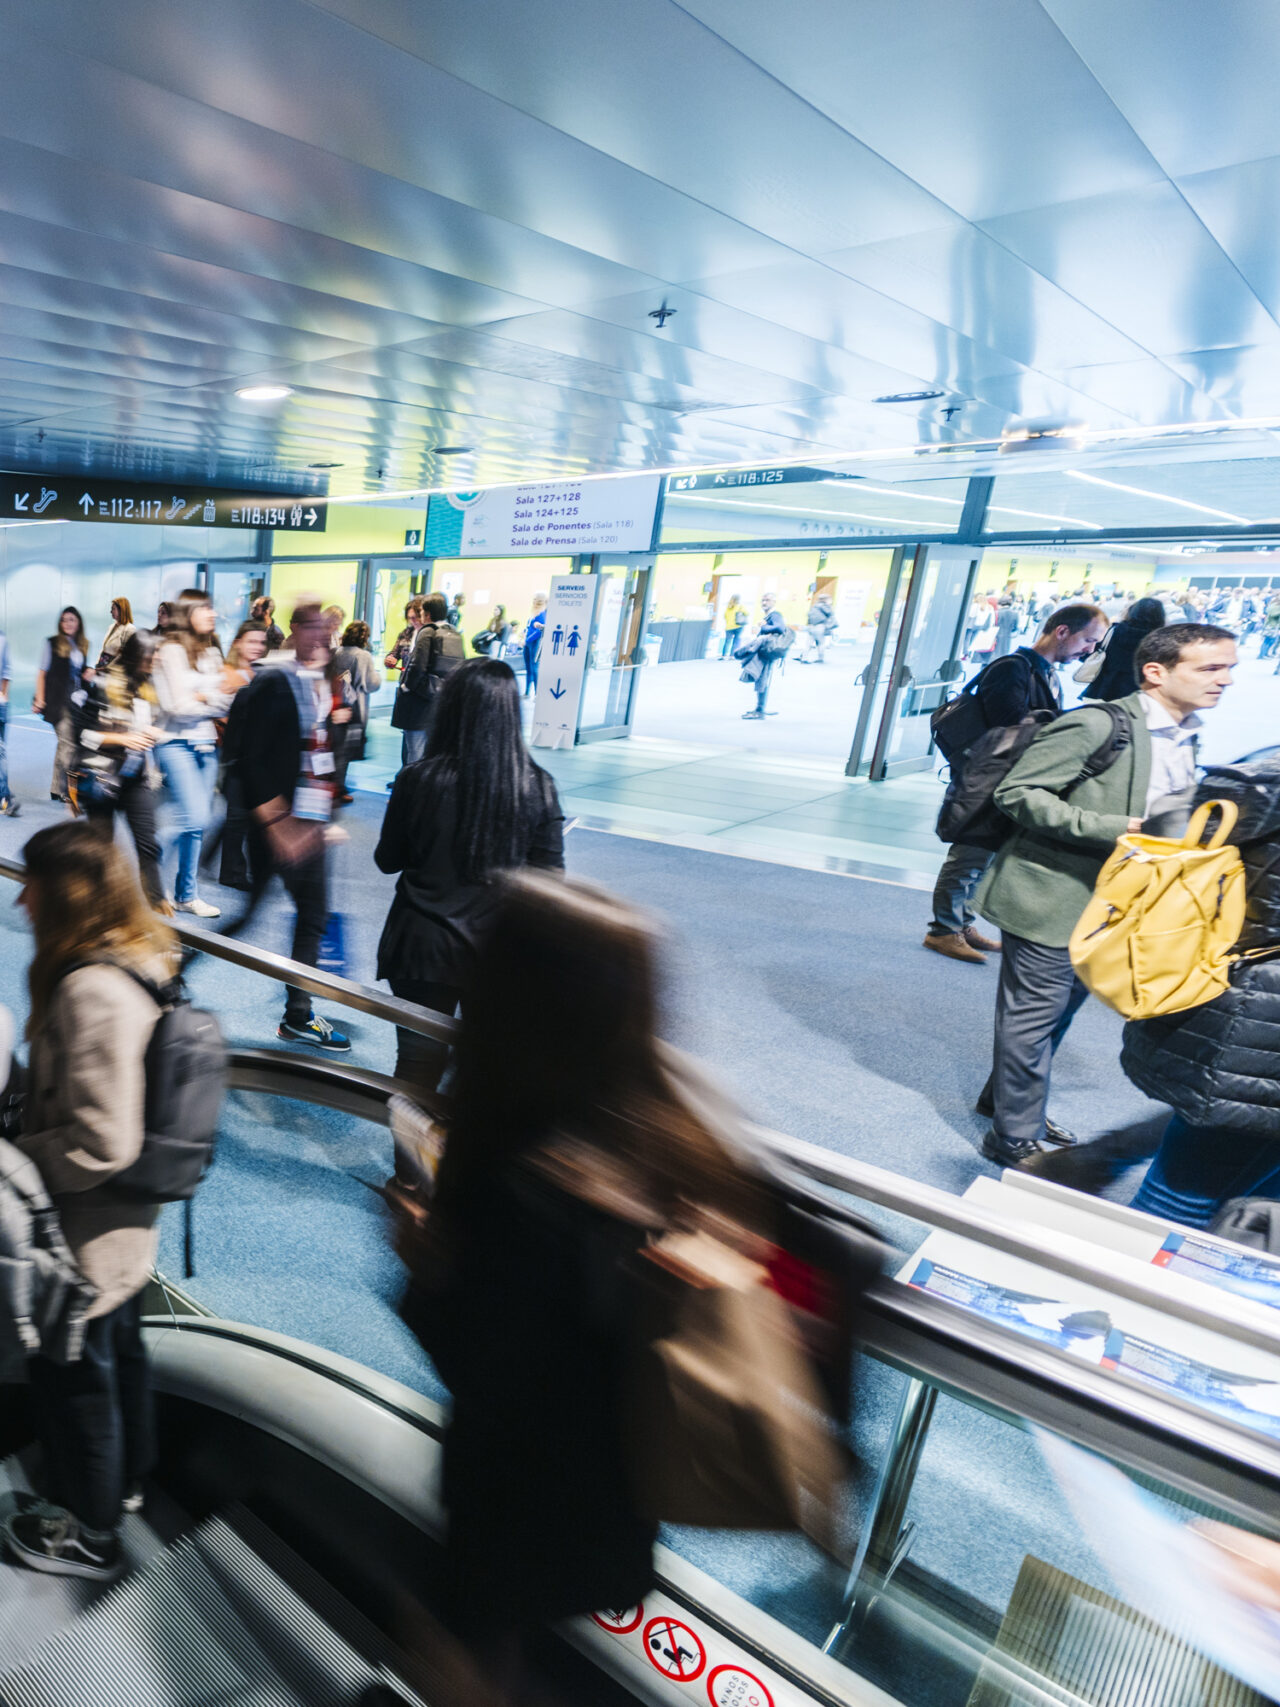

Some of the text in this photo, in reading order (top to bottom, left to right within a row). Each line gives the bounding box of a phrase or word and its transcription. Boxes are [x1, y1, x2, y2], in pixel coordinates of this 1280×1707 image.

[516, 492, 581, 505] Sala 127+128
[514, 507, 579, 518] Sala 124+125
[512, 524, 531, 532] Sala
[533, 522, 545, 531] de
[547, 521, 592, 531] Ponentes
[511, 538, 529, 546] Sala
[531, 537, 543, 546] de
[545, 536, 577, 545] Prensa
[729, 1680, 749, 1707] OLOS
